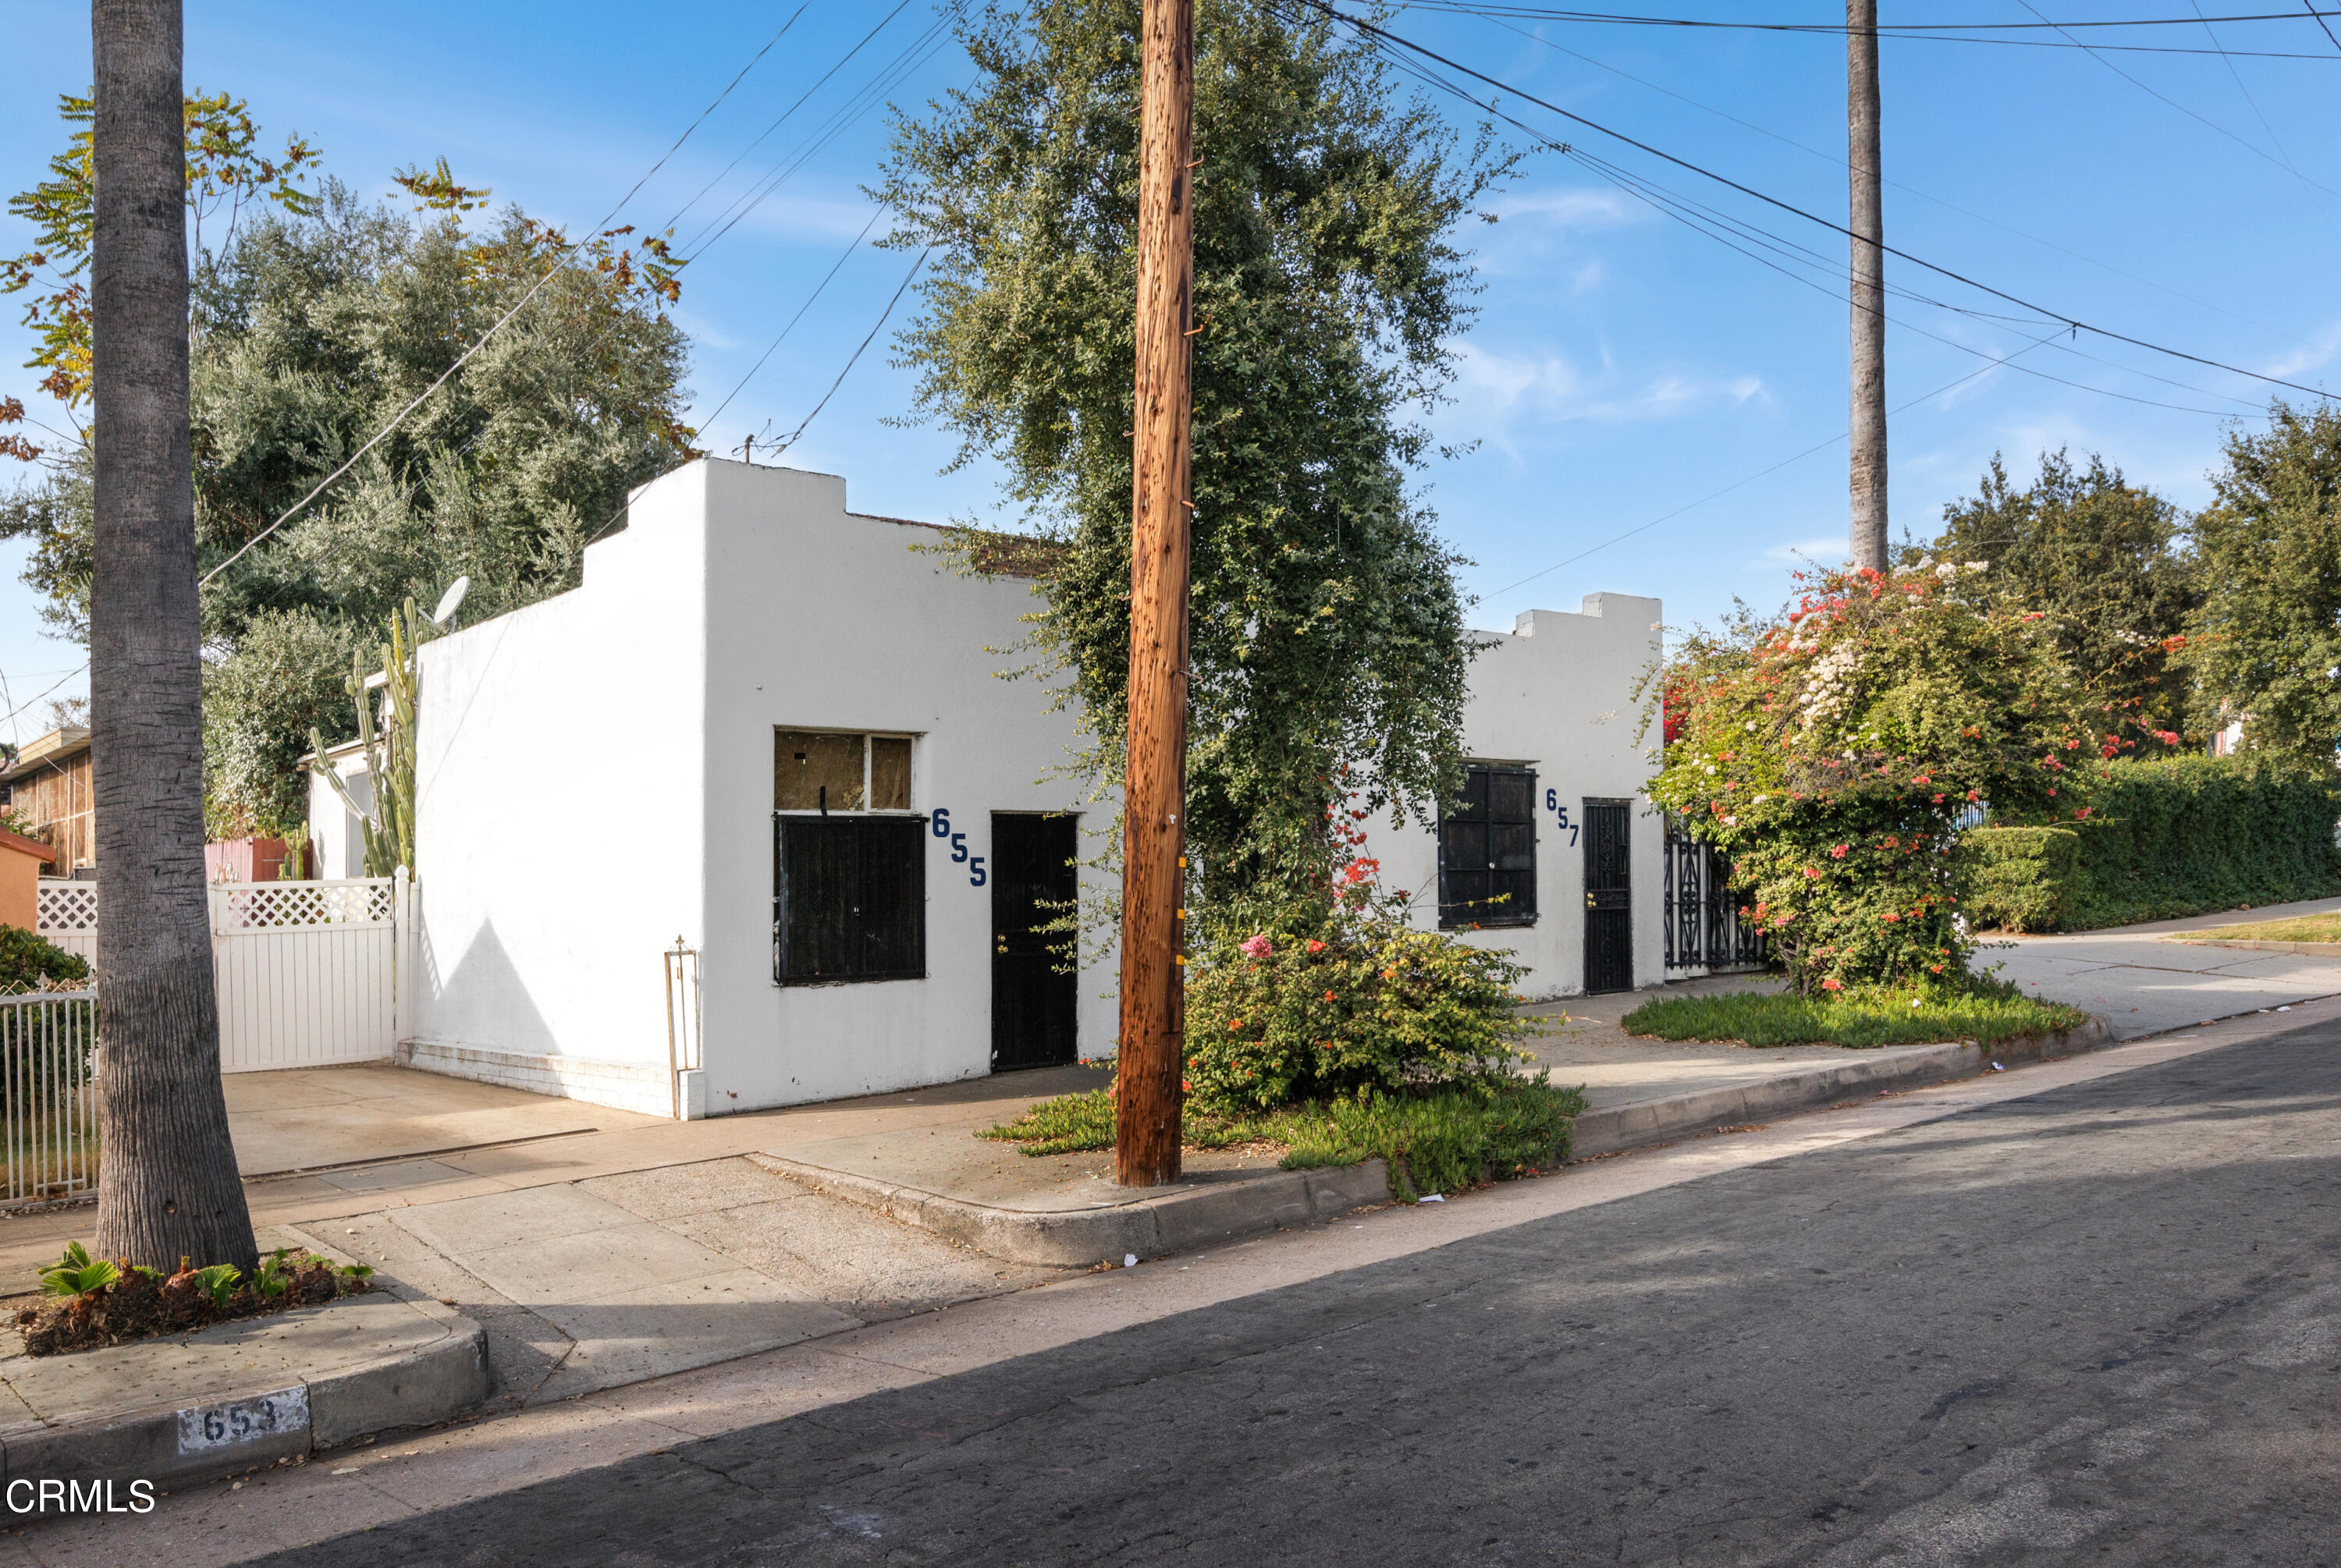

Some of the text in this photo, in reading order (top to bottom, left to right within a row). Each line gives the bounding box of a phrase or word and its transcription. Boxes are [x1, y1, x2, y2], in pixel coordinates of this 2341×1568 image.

[1546, 789, 1579, 846] 657
[932, 808, 986, 886] 655
[204, 1399, 276, 1441] 653
